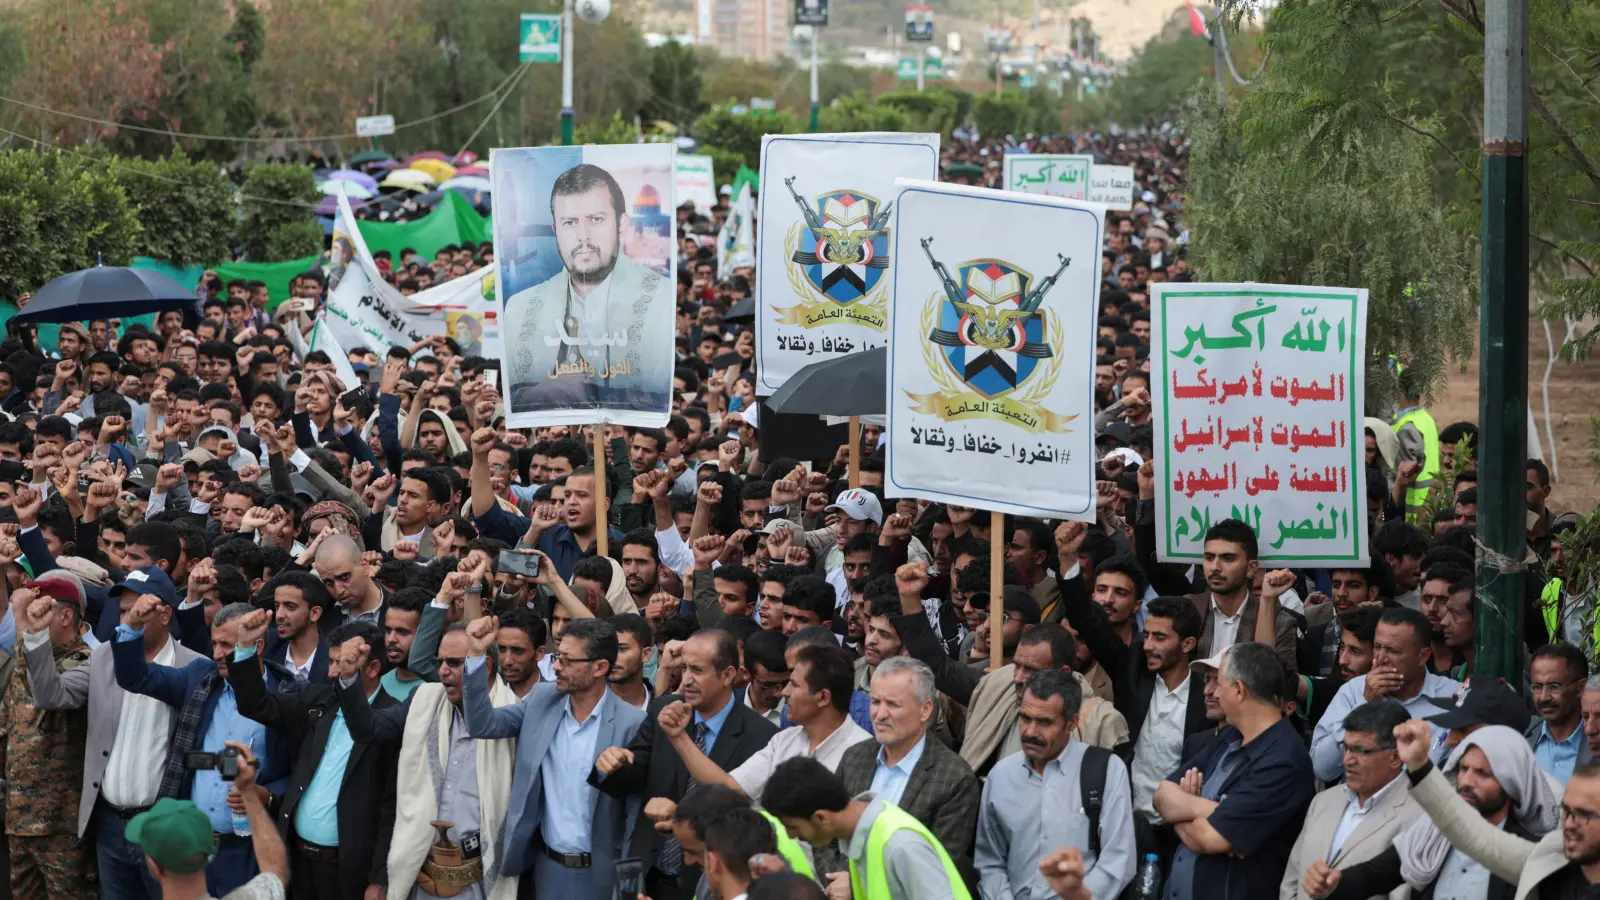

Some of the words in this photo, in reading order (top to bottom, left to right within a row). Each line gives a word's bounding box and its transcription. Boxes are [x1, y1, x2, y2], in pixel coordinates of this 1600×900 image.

[1058, 164, 1084, 183] الله
[806, 309, 843, 324] العامة
[845, 308, 884, 328] التعبئة
[1170, 298, 1277, 365] أكبر
[1281, 306, 1346, 353] الله
[547, 358, 595, 379] والفعل
[599, 359, 632, 378] القول
[1172, 361, 1263, 405] لأمريكا
[1270, 373, 1345, 406] الموت
[944, 401, 989, 417] العامة
[992, 402, 1037, 428] التعبئة
[1173, 415, 1263, 453] لإسرائيل
[1271, 419, 1346, 453] الموت
[1173, 461, 1237, 498] اليهود
[1245, 463, 1280, 496] على
[1289, 463, 1346, 493] اللعنة
[1269, 502, 1348, 549] النصر
